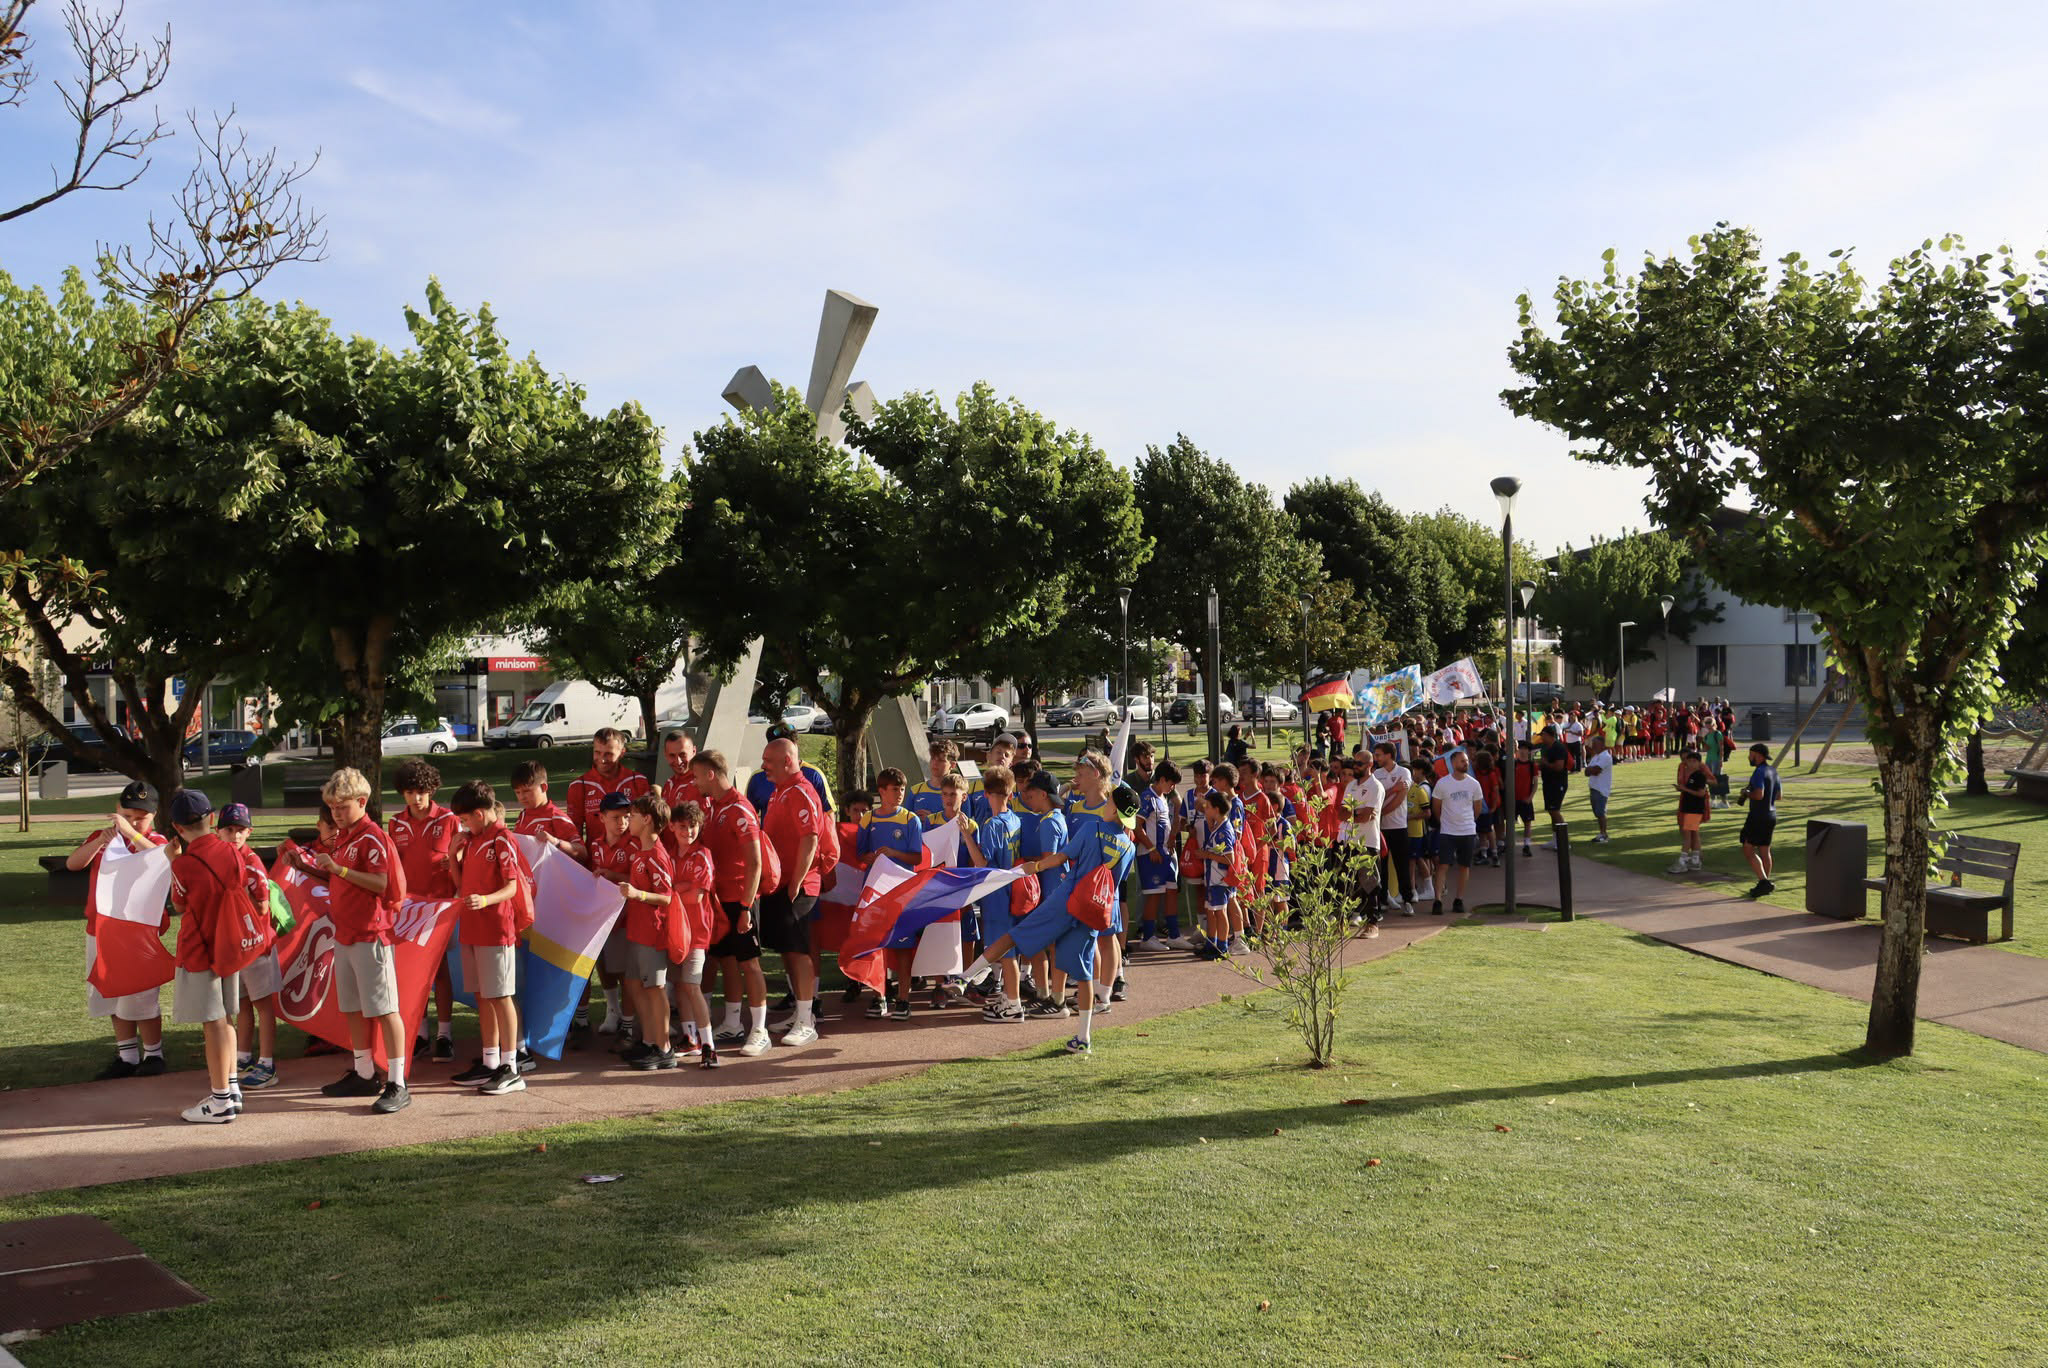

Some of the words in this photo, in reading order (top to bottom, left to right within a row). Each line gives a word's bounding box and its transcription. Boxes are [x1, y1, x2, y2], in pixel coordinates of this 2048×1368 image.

[495, 658, 536, 669] minisom
[175, 680, 186, 694] P
[1103, 845, 1121, 871] 7
